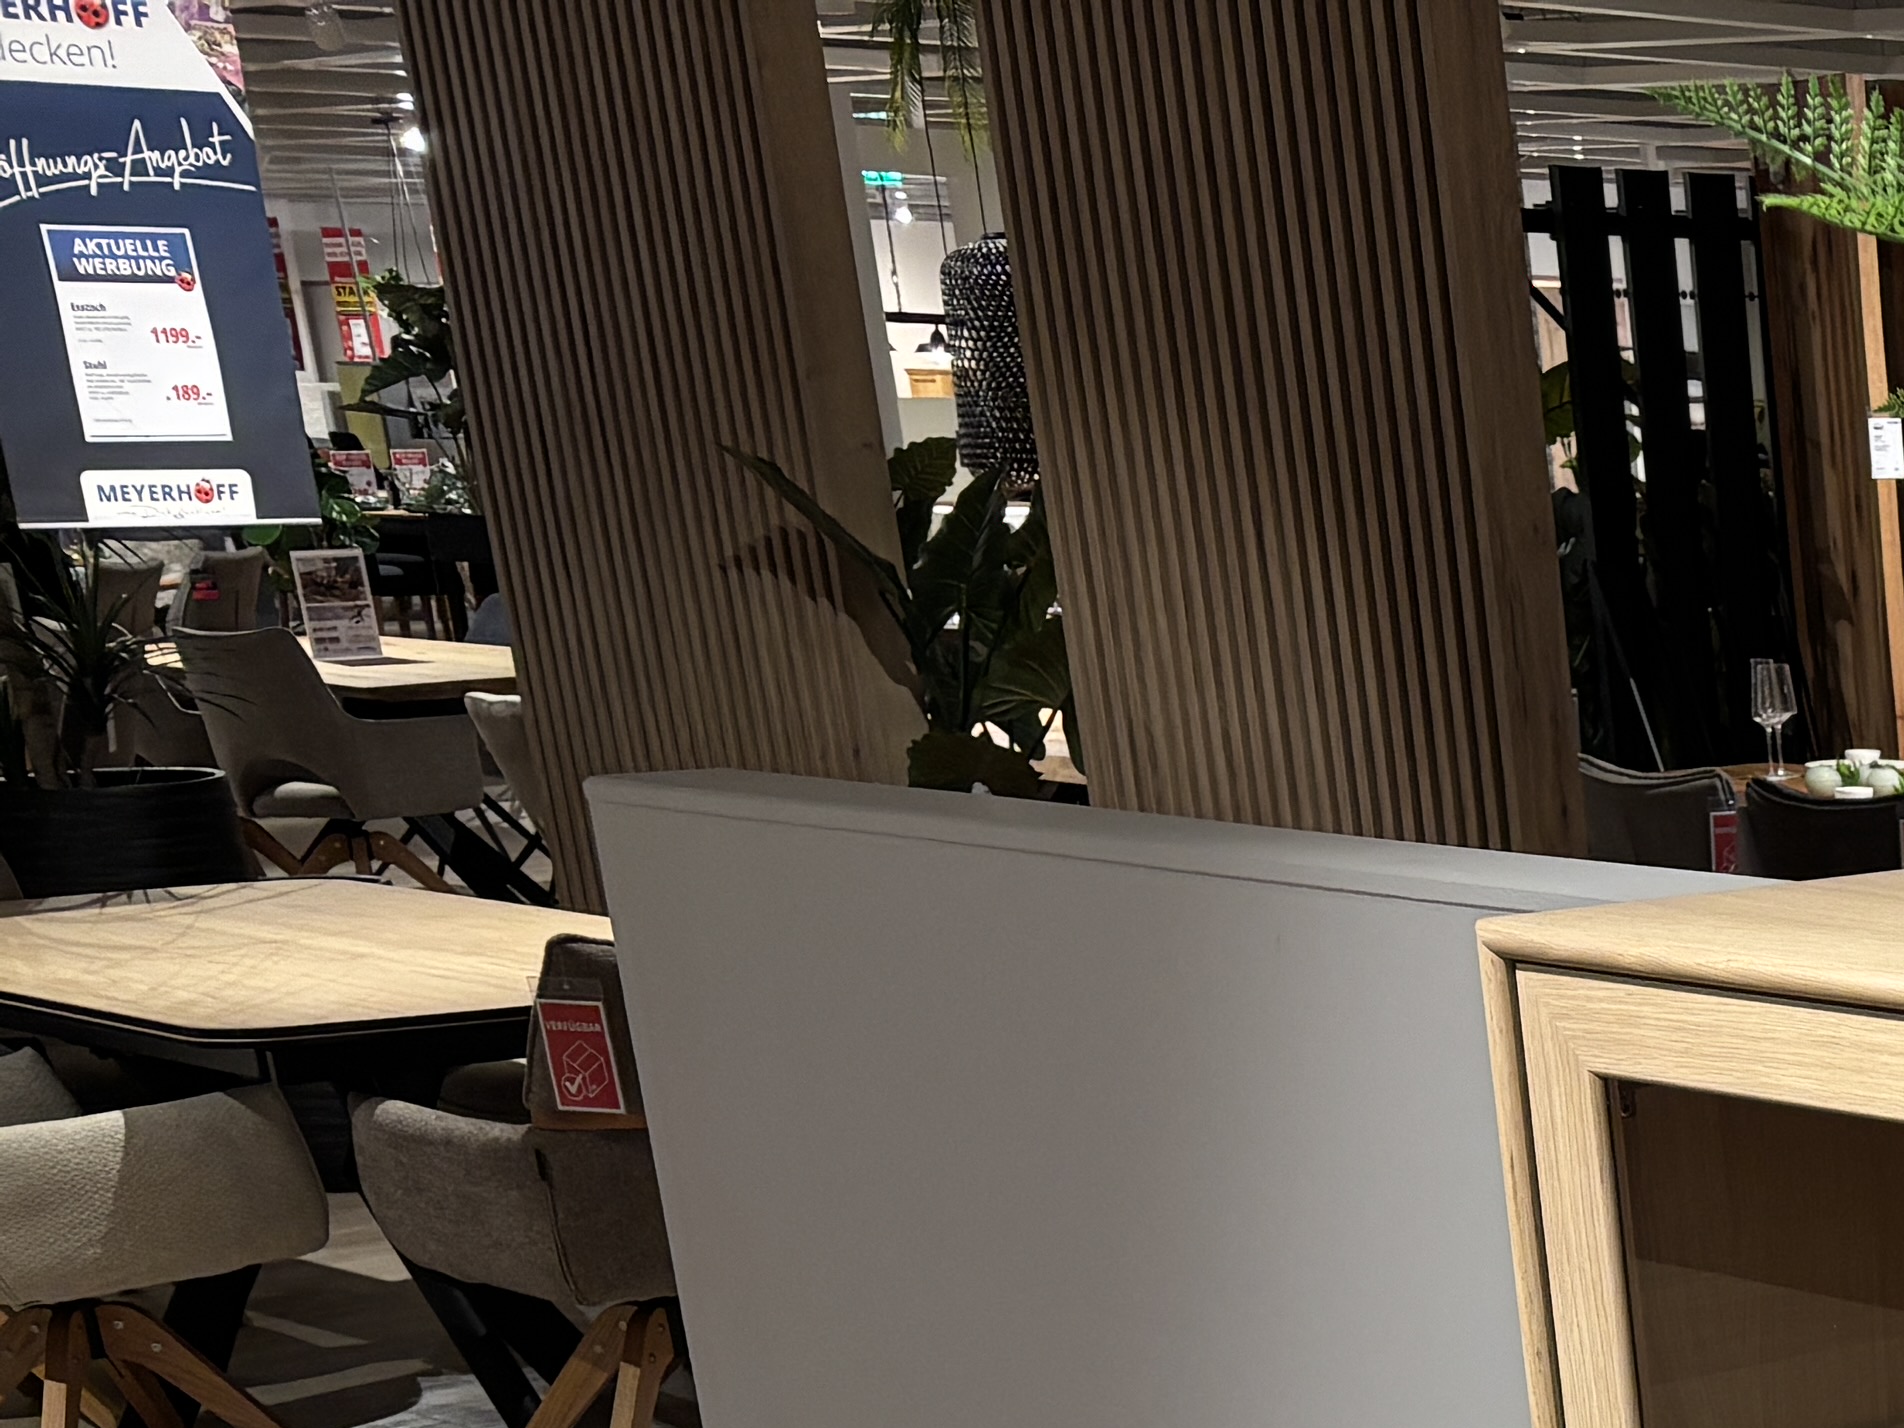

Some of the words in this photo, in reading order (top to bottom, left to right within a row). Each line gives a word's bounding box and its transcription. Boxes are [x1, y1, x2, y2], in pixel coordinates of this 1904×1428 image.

[73, 238, 171, 257] AKTUELLE
[73, 257, 176, 277] WERBUNG
[150, 326, 202, 344] 1199.-
[96, 478, 239, 504] MEYERHOFF
